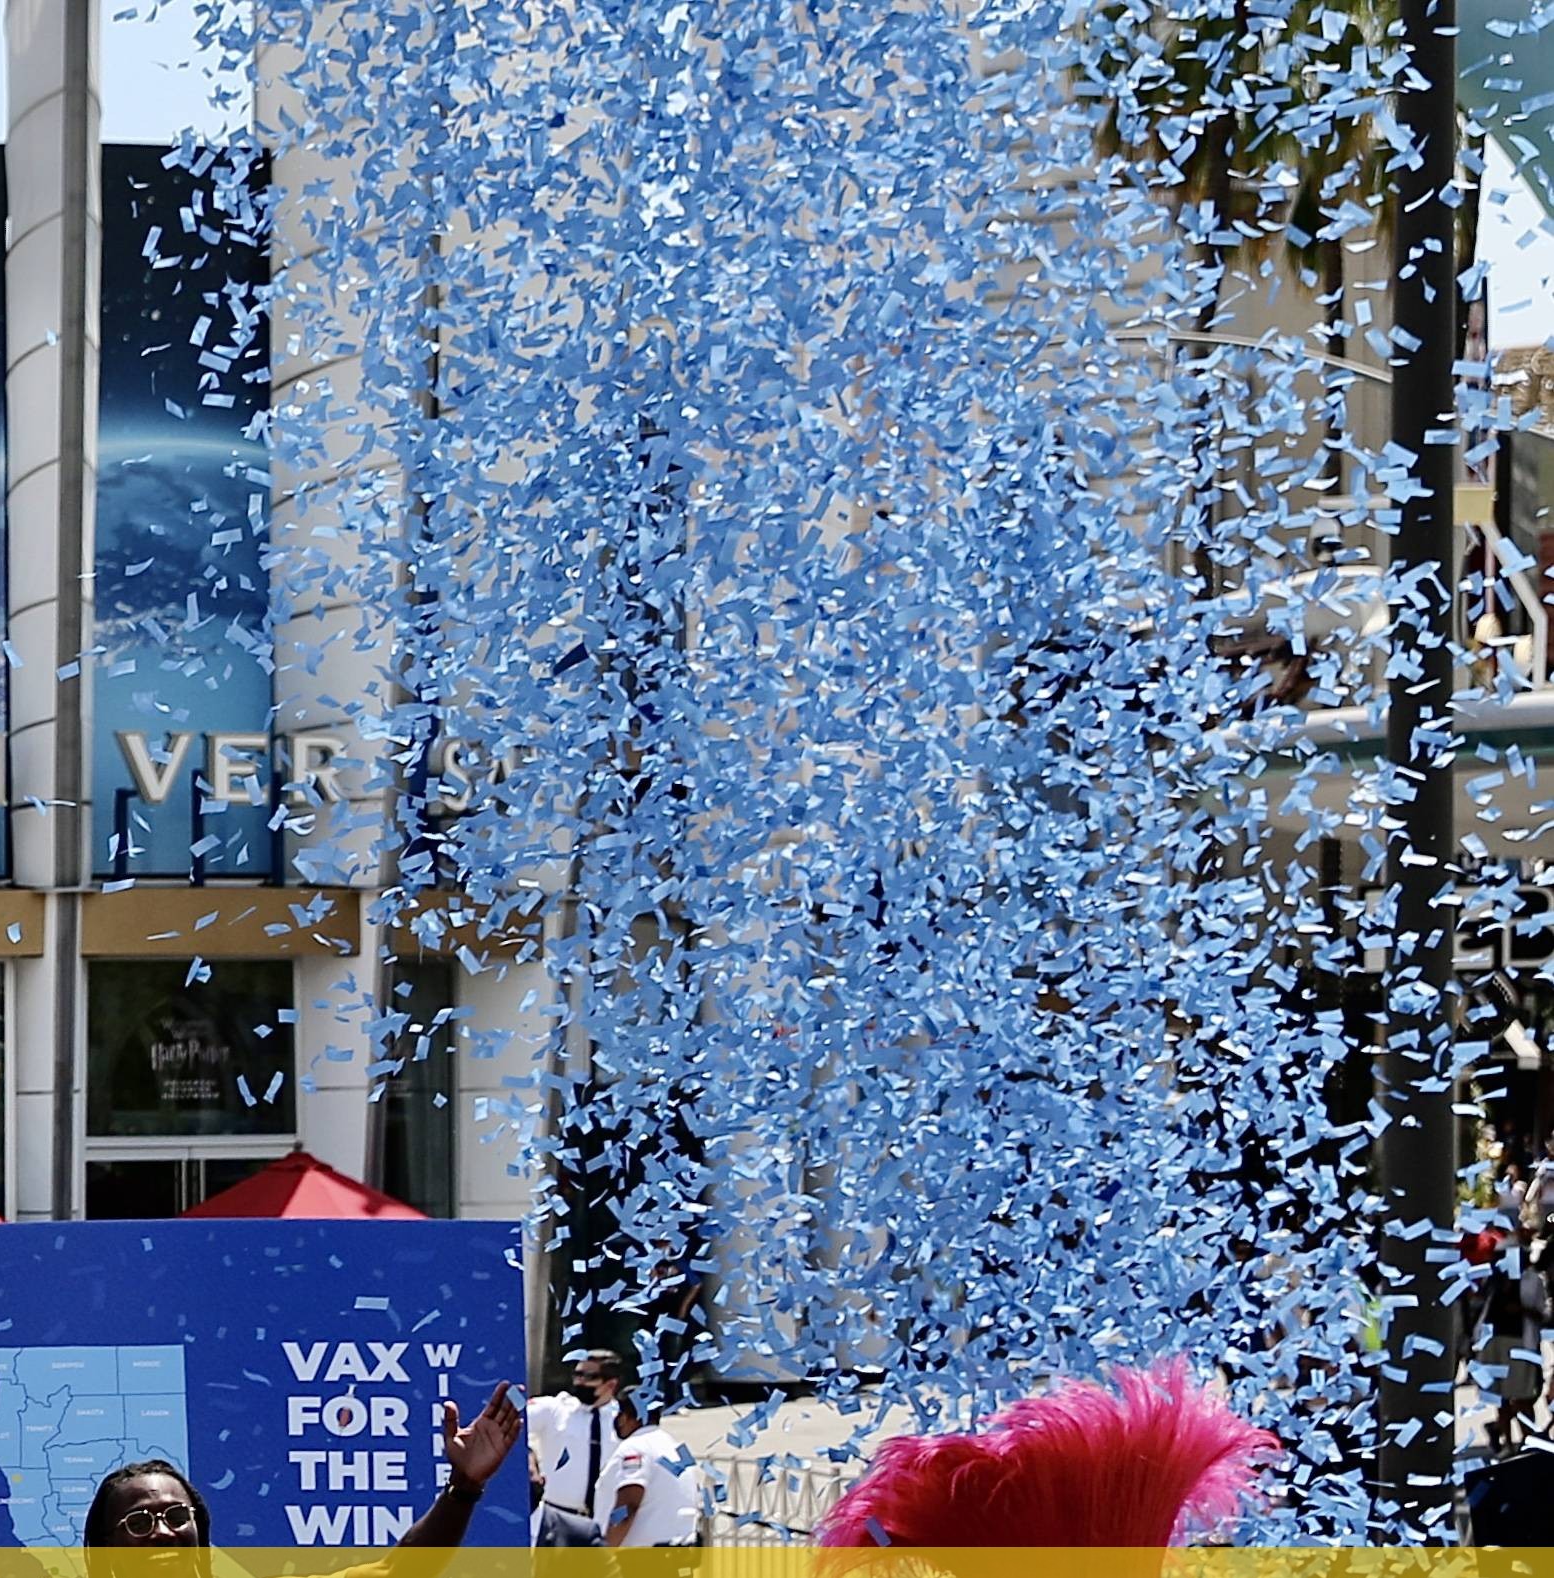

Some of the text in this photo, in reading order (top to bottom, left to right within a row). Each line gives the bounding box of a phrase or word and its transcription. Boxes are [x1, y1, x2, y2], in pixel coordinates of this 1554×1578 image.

[281, 1342, 411, 1382] VAX
[287, 1394, 410, 1437] FOR
[288, 1451, 408, 1491] THE
[284, 1505, 414, 1546] WIN
